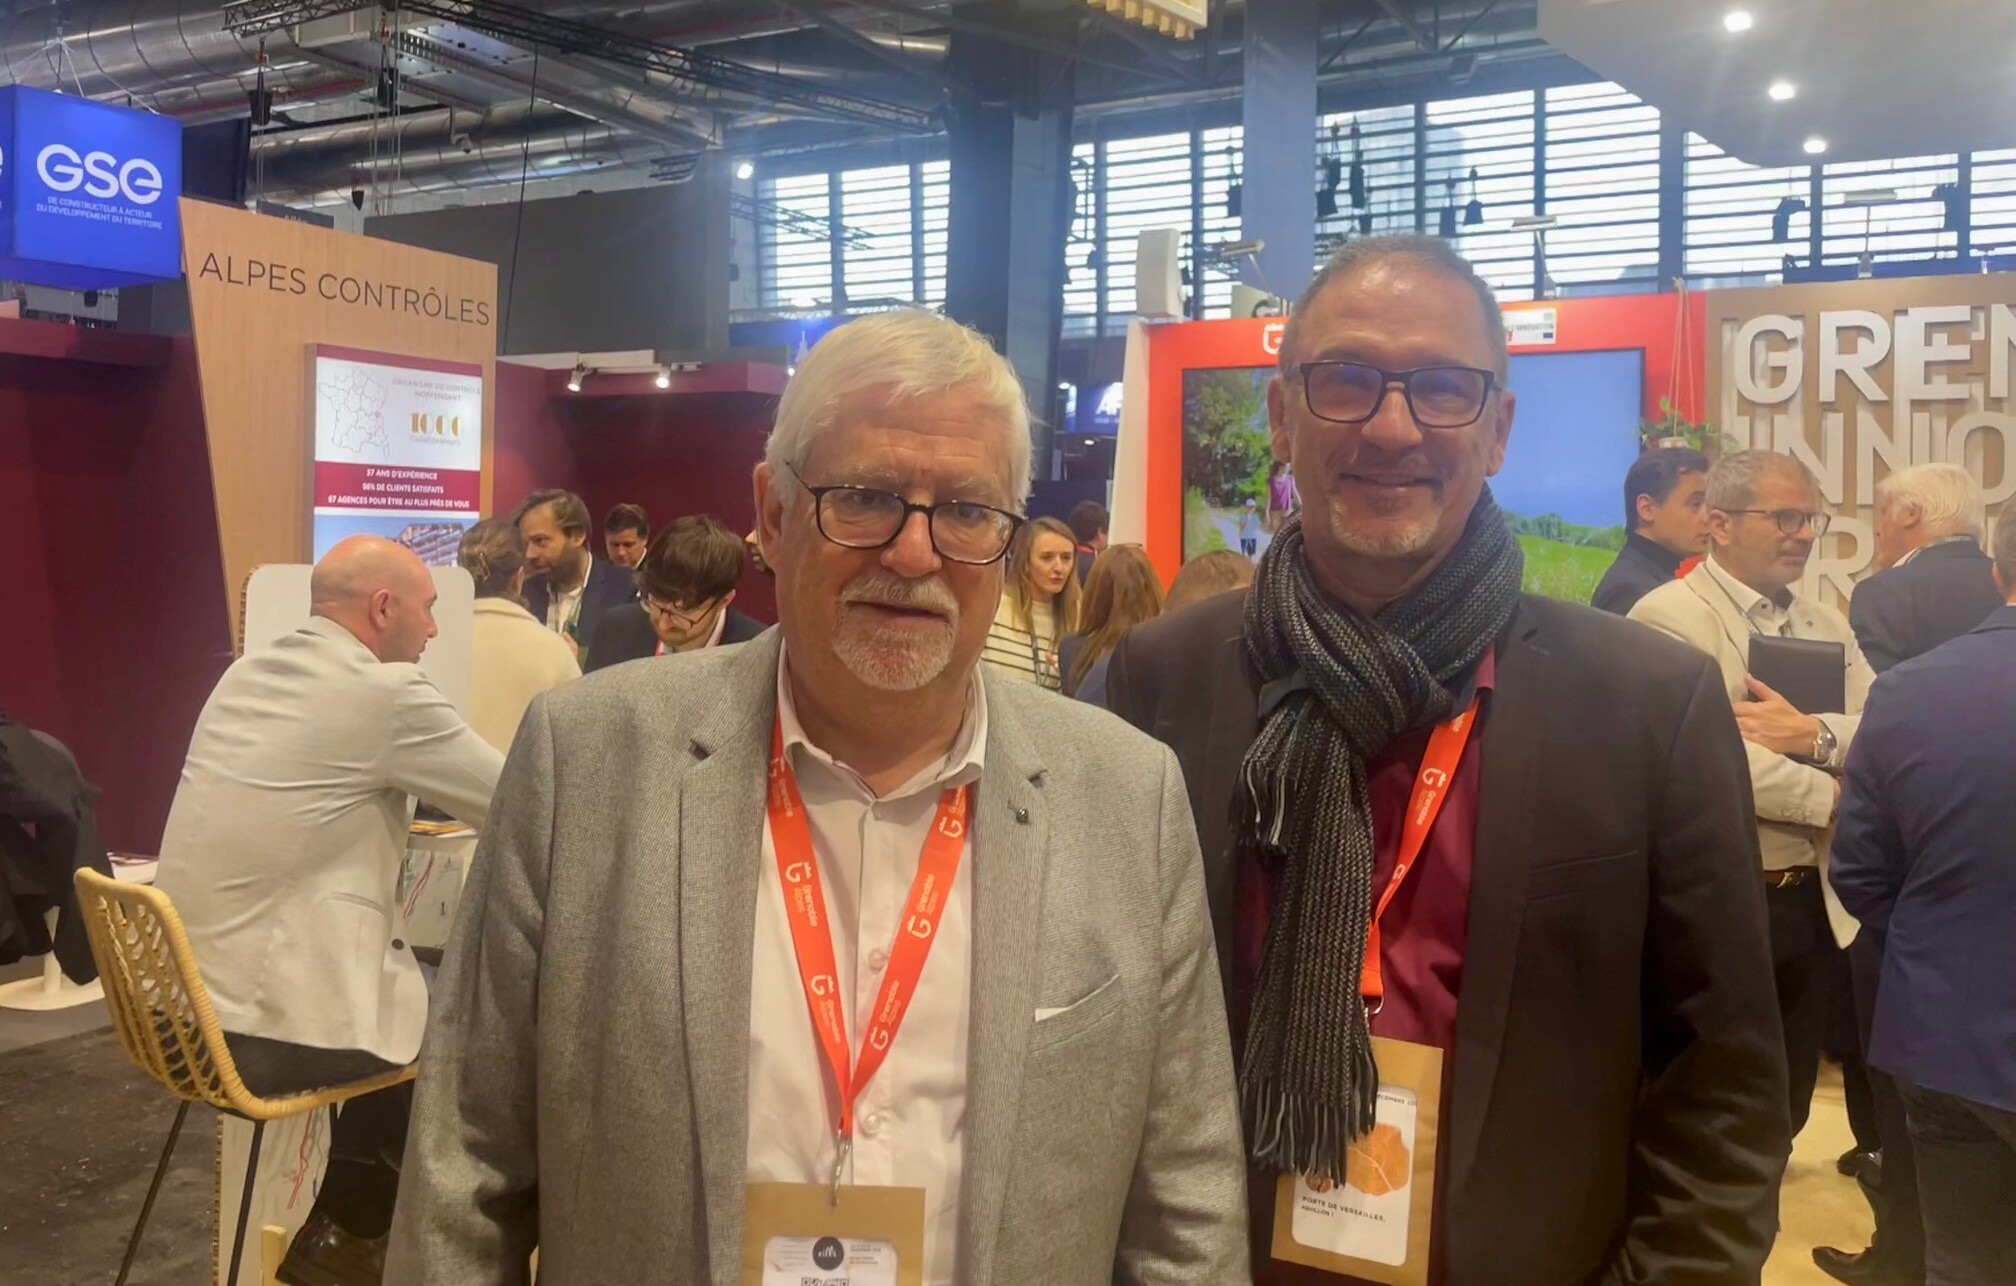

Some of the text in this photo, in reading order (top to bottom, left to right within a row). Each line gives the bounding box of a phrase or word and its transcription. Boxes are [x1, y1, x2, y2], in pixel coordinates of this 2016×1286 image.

[36, 203, 48, 212] DU
[124, 216, 163, 230] TERRITOIRE
[48, 196, 58, 204] DE
[59, 197, 118, 213] CONSTRUCTEUR
[125, 208, 153, 219] ACTEUR
[199, 252, 490, 326] ALPES CONTRÔLES
[375, 469, 390, 478] ANS
[337, 495, 368, 505] AGENCES
[368, 497, 387, 505] POUR
[387, 496, 403, 506] ÊTRE
[404, 498, 413, 506] AU
[413, 498, 429, 507] PLUS
[445, 499, 454, 508] DE
[454, 500, 470, 508] VOUS
[376, 483, 385, 492] DE
[386, 484, 411, 493] CLIENTS
[412, 485, 444, 494] SATISFAITS
[1416, 790, 1437, 826] Grenoble
[803, 884, 818, 928] Grenoble
[916, 873, 935, 913] Grenoble
[879, 979, 900, 1023] Grenoble
[1302, 1195, 1326, 1206] PORTE
[1327, 1202, 1338, 1210] DE
